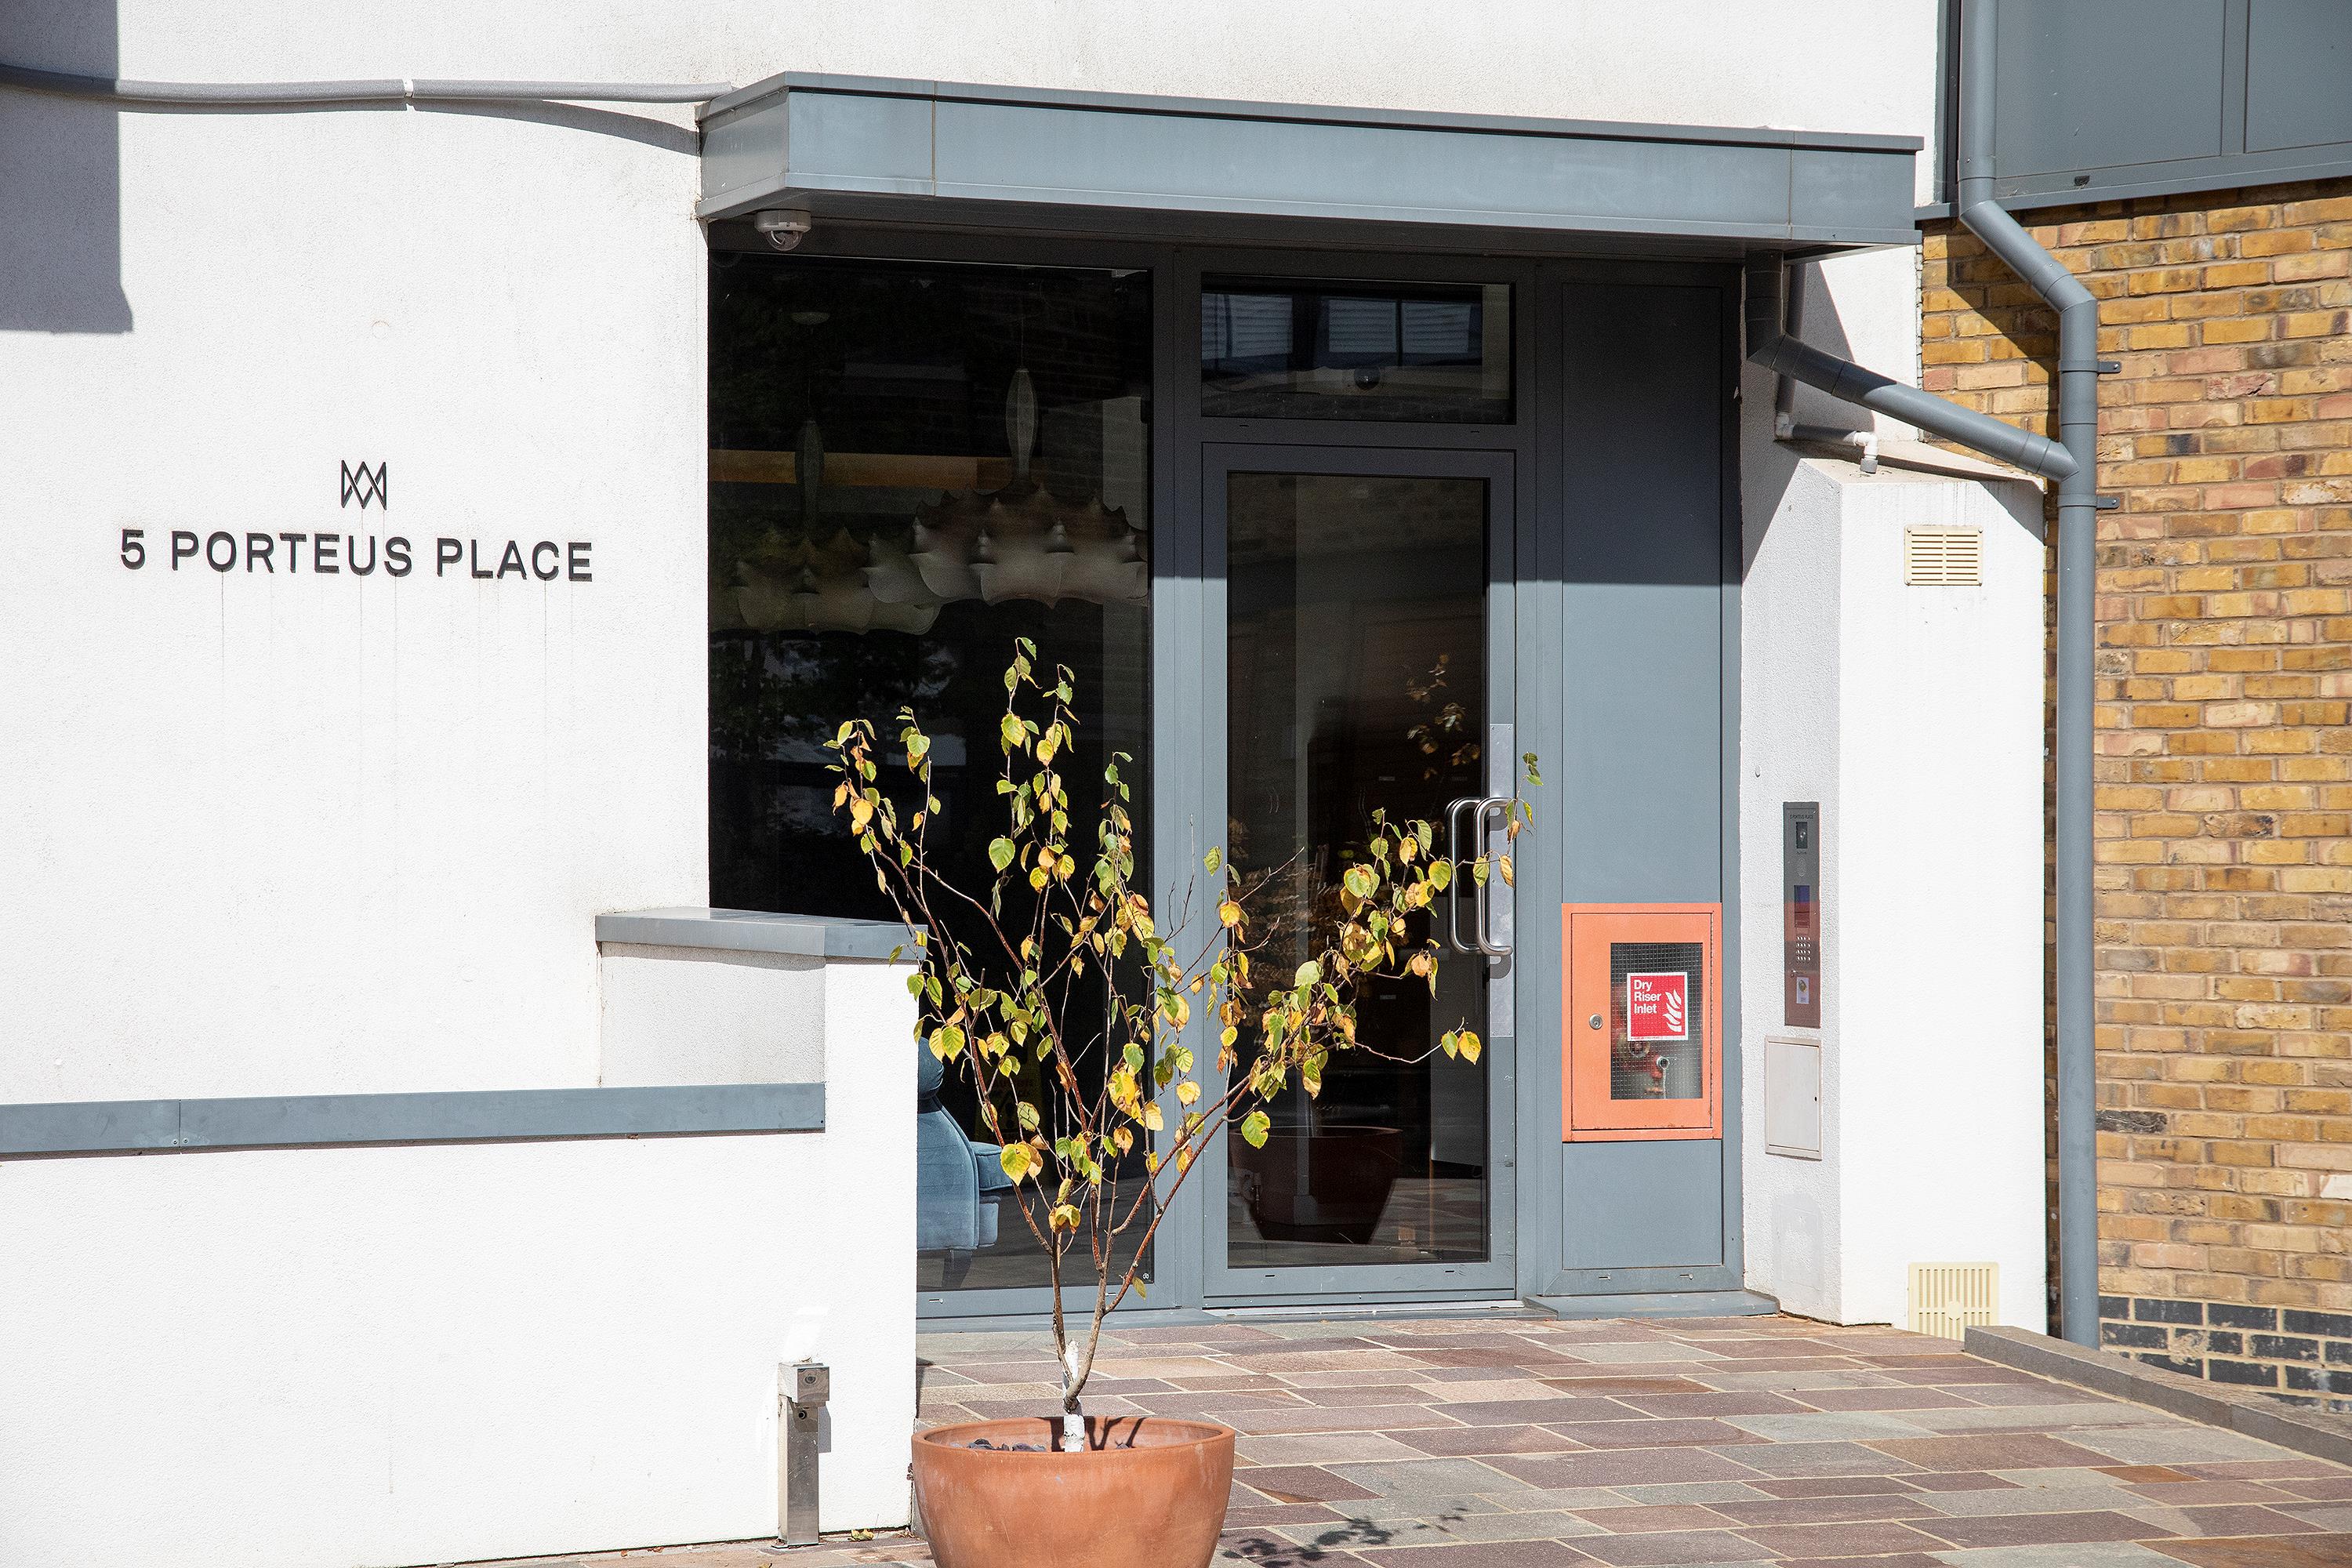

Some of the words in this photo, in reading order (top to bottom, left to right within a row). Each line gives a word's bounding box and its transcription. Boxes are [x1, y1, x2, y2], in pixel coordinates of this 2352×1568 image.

[121, 529, 146, 570] 5
[172, 531, 412, 578] PORTEUS
[437, 538, 593, 583] PLACE
[1634, 979, 1653, 992] Dry
[1634, 991, 1662, 1002] Riser
[1634, 1004, 1657, 1014] Inlet
